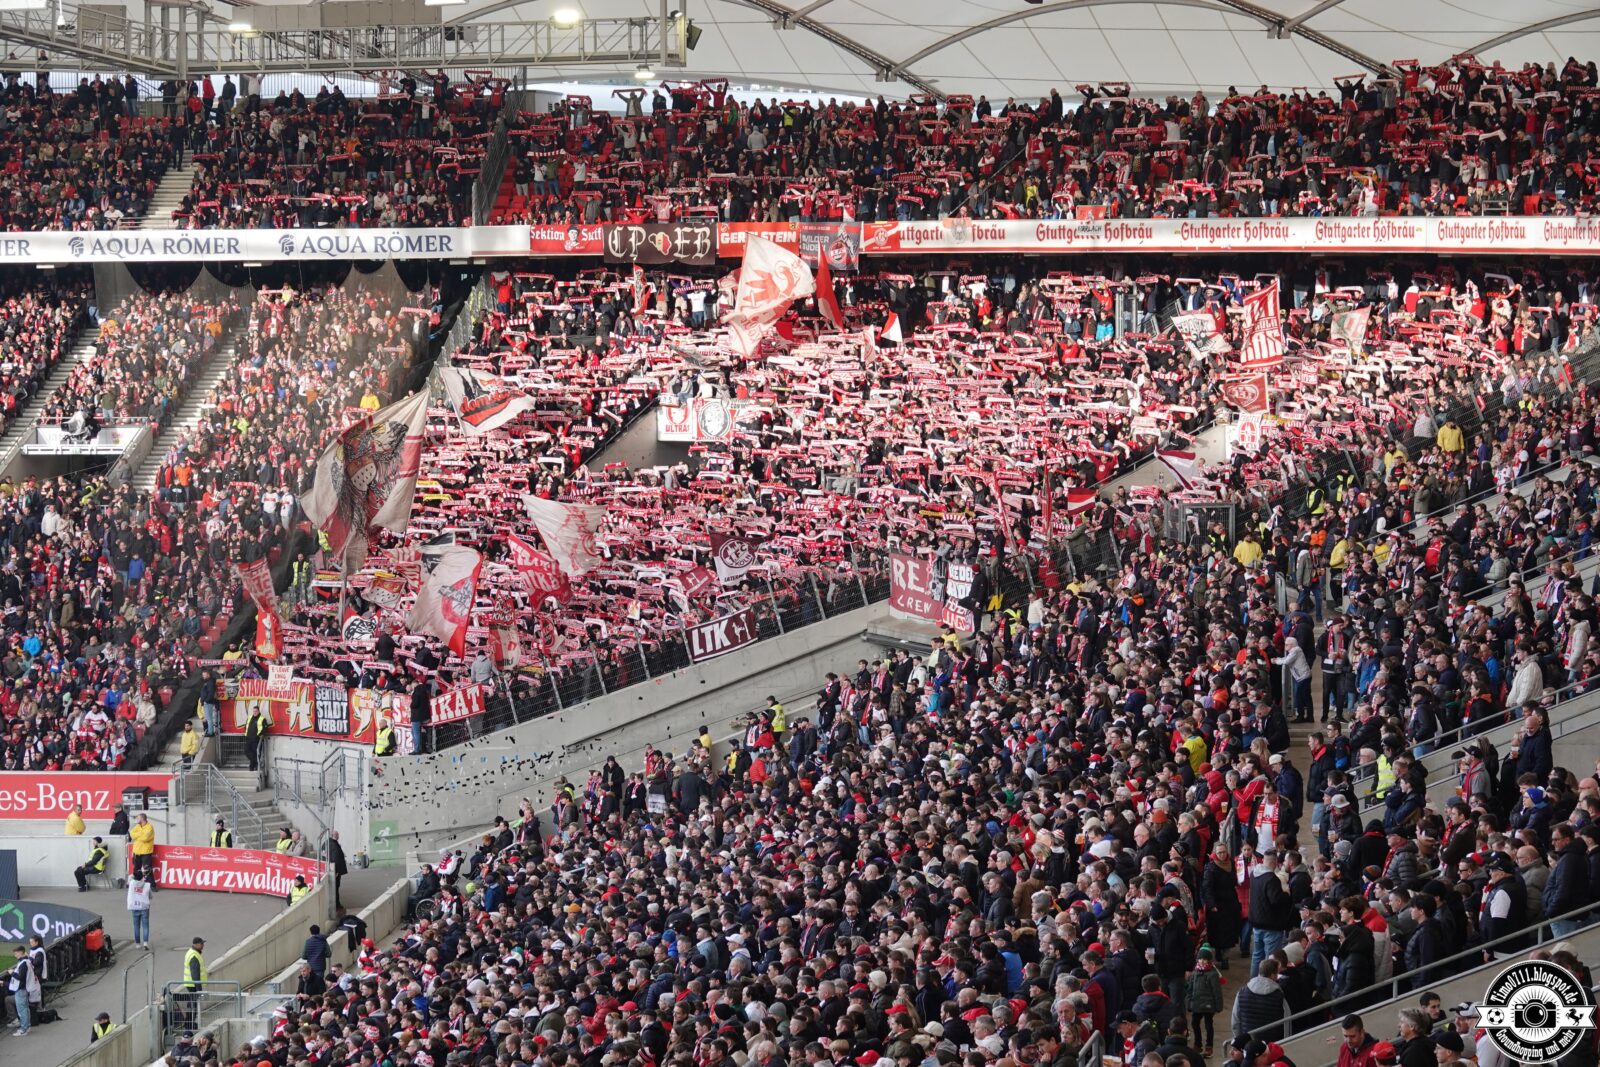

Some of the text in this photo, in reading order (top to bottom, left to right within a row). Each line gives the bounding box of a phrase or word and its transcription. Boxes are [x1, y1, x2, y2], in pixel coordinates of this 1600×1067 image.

[530, 226, 565, 241] Sektion
[1104, 222, 1153, 243] Hofbräu
[1180, 220, 1289, 243] Stuttgarter Hofbräu
[1315, 219, 1415, 243] Stuttgarter Hofbräu
[1437, 219, 1526, 244] Stuttgarter Hofbräu
[1543, 219, 1586, 245] Stuttgarter
[0, 239, 31, 256] ER
[90, 233, 240, 258] AQUA RÖMER
[300, 231, 453, 257] AQUA RÖMER
[691, 619, 731, 657] LTK
[316, 700, 348, 720] STADT
[317, 719, 348, 733] VERBOT
[0, 783, 110, 812] es-Benz
